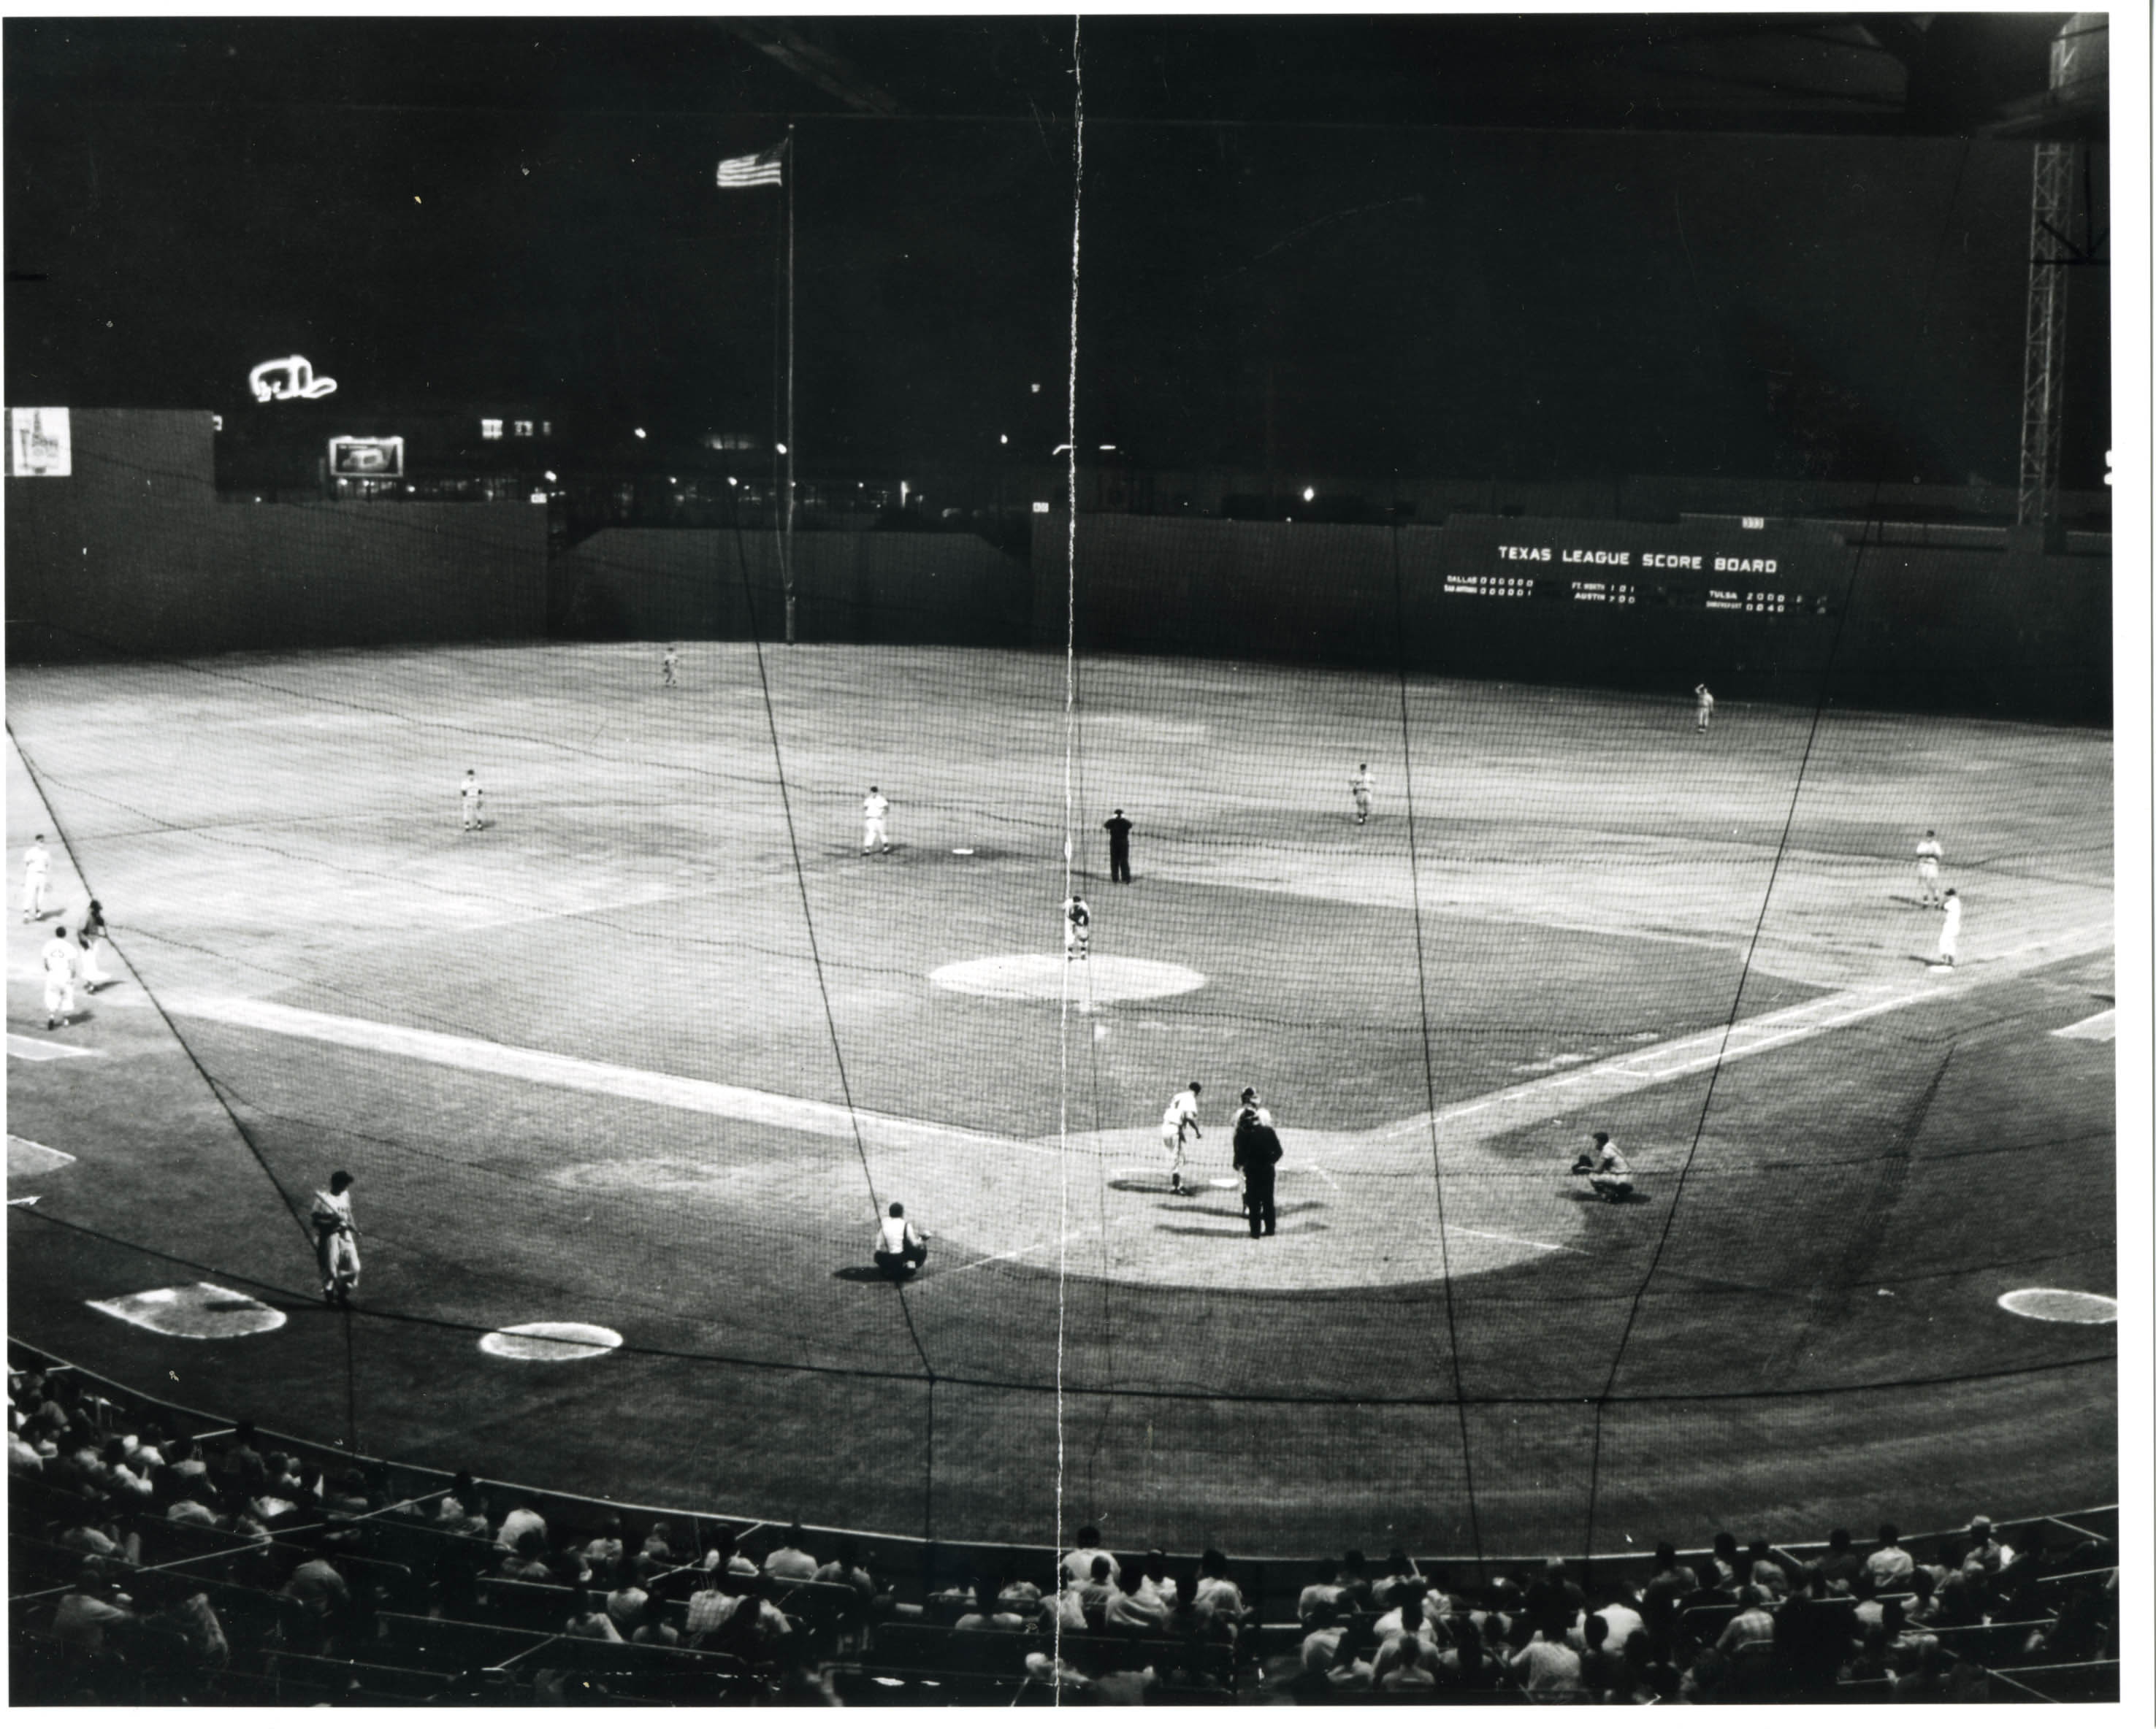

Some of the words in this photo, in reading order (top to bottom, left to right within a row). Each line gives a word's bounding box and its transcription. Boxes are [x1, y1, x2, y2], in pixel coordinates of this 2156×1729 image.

[1498, 545, 1552, 561] TEXAS
[1562, 549, 1630, 565] LEAGUE
[1642, 553, 1702, 570] SCORE
[1714, 557, 1777, 573] BOARD
[1575, 592, 1605, 600] AUSTIN
[1709, 590, 1738, 599] TULSA
